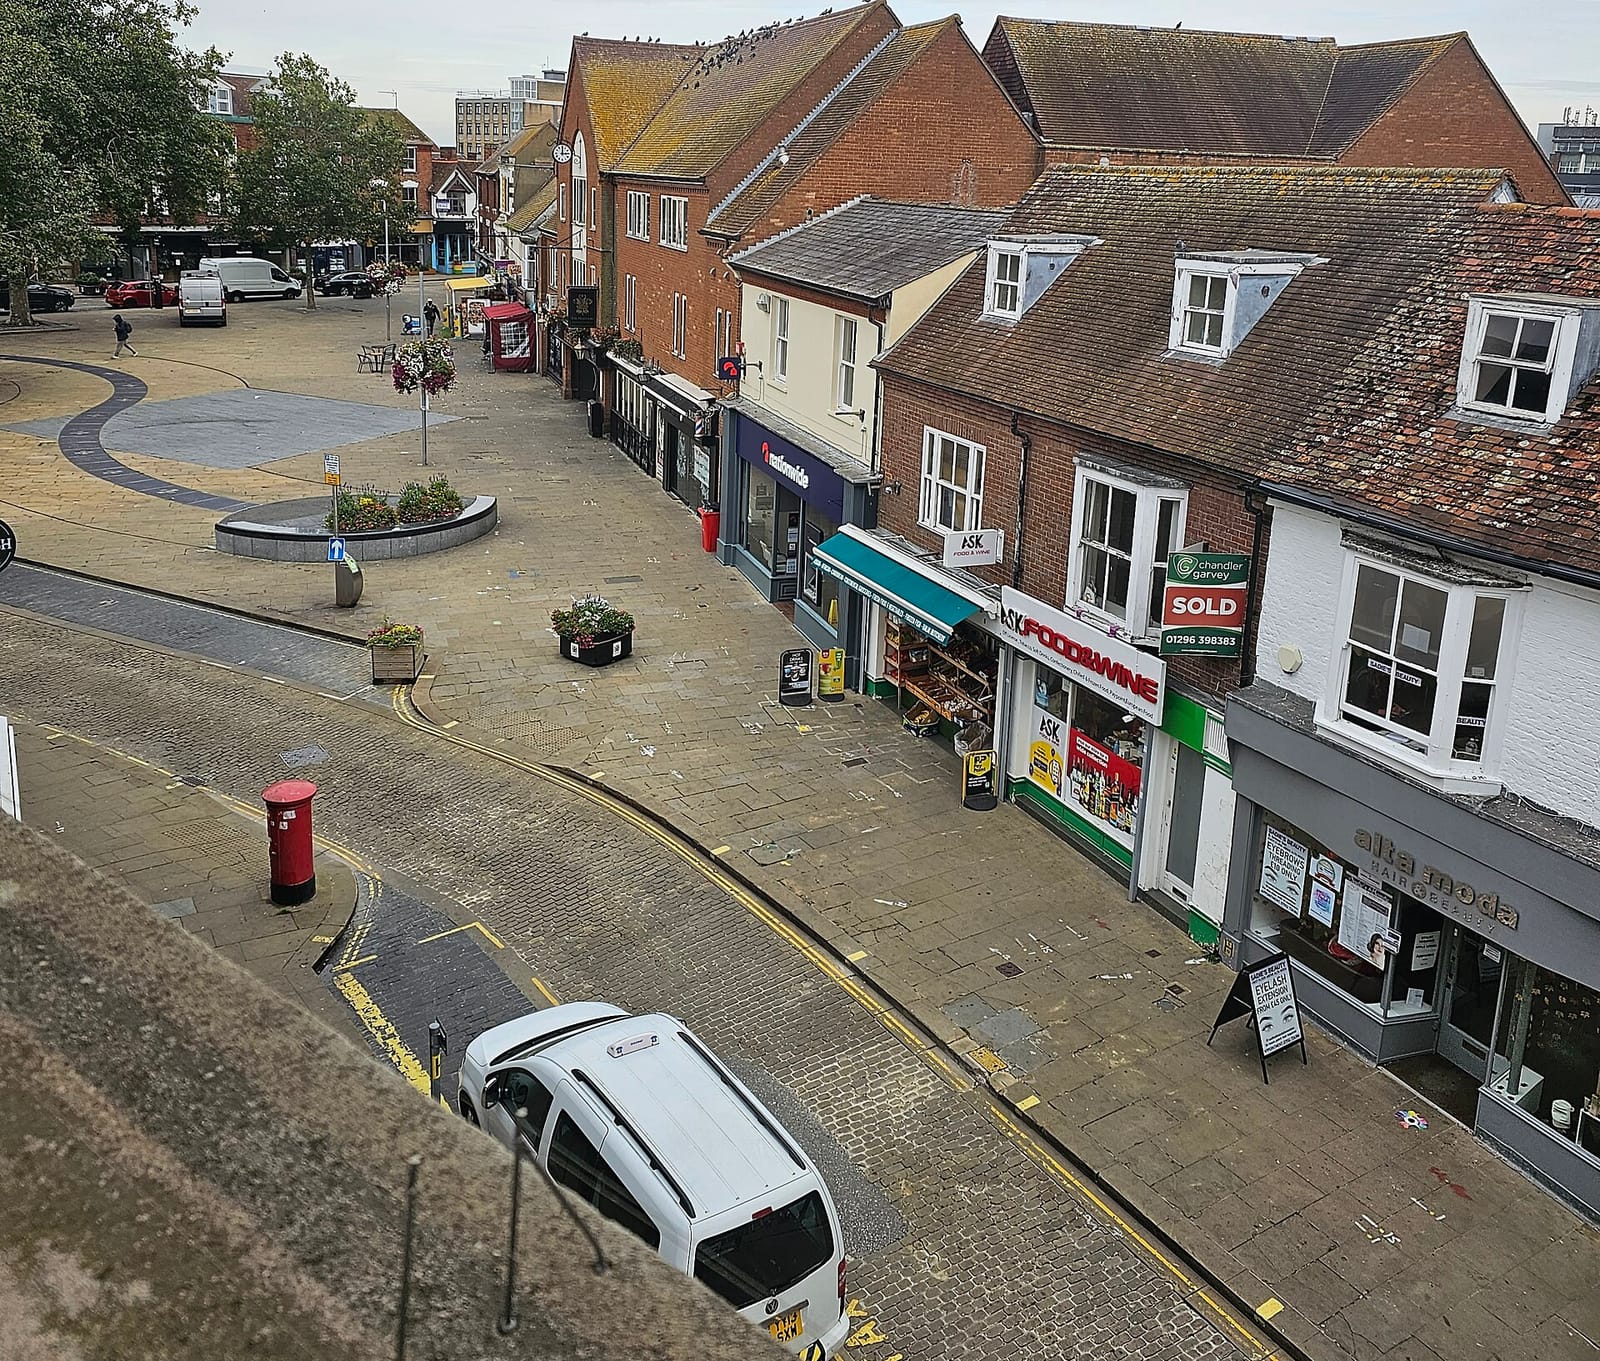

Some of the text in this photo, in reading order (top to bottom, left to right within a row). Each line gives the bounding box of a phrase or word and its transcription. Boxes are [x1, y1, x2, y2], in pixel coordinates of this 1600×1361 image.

[768, 452, 809, 489] nationwide
[961, 534, 985, 550] ASK
[1192, 571, 1230, 581] garvey
[1198, 560, 1243, 571] chandler
[1171, 596, 1237, 616] SOLD
[1000, 601, 1025, 634] ASK
[1165, 635, 1236, 646] 01296 398383
[1395, 670, 1420, 685] BEAUTY
[1040, 714, 1060, 742] ASK
[1457, 717, 1486, 726] BEAUTY
[1266, 841, 1305, 870] EYEBROWS
[1269, 852, 1300, 876] THREADING
[1281, 867, 1298, 881] ONLY
[1354, 828, 1416, 877] alta
[1423, 865, 1519, 930] moda
[1371, 860, 1407, 888] HAIR
[1411, 880, 1427, 900] &
[1429, 892, 1496, 934] BEAUTY
[1255, 974, 1287, 996] EYELASH
[1257, 984, 1289, 1005] EXTENSION
[1257, 1003, 1270, 1015] FROM
[1280, 994, 1293, 1005] ONLY
